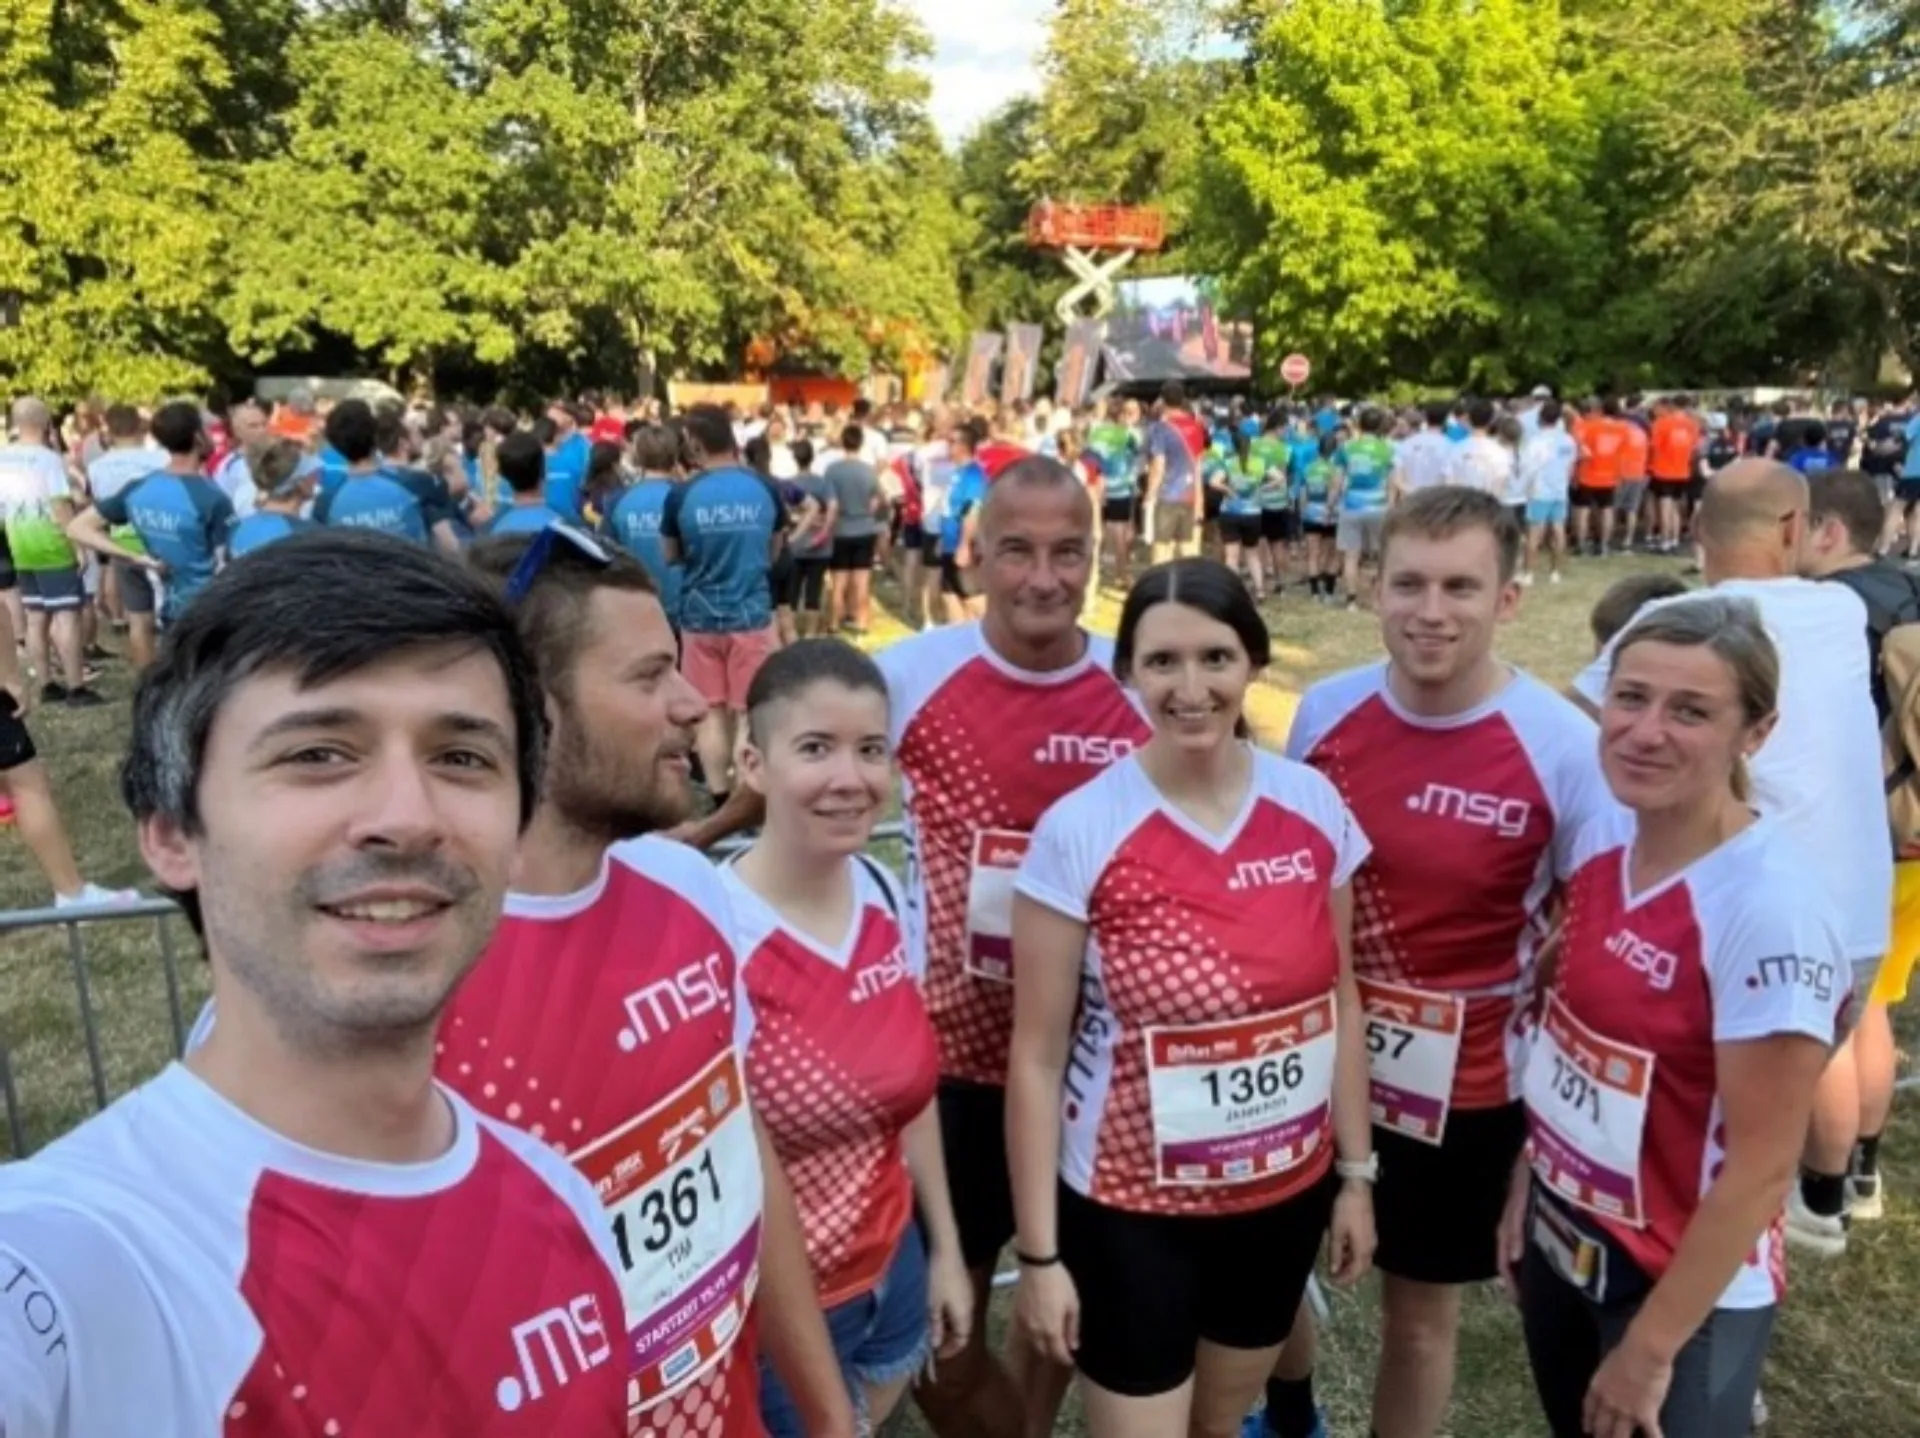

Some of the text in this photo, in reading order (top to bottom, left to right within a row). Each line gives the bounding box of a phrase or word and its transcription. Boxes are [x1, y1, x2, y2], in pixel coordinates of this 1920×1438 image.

[1406, 782, 1531, 837] .msg
[1228, 848, 1318, 891] .msg
[1604, 927, 1678, 991] .msg
[1745, 953, 1834, 1002] .msg
[1366, 1020, 1415, 1060] 57
[1201, 1052, 1304, 1107] 1366
[611, 1147, 721, 1271] 1361
[497, 1293, 611, 1412] .ms
